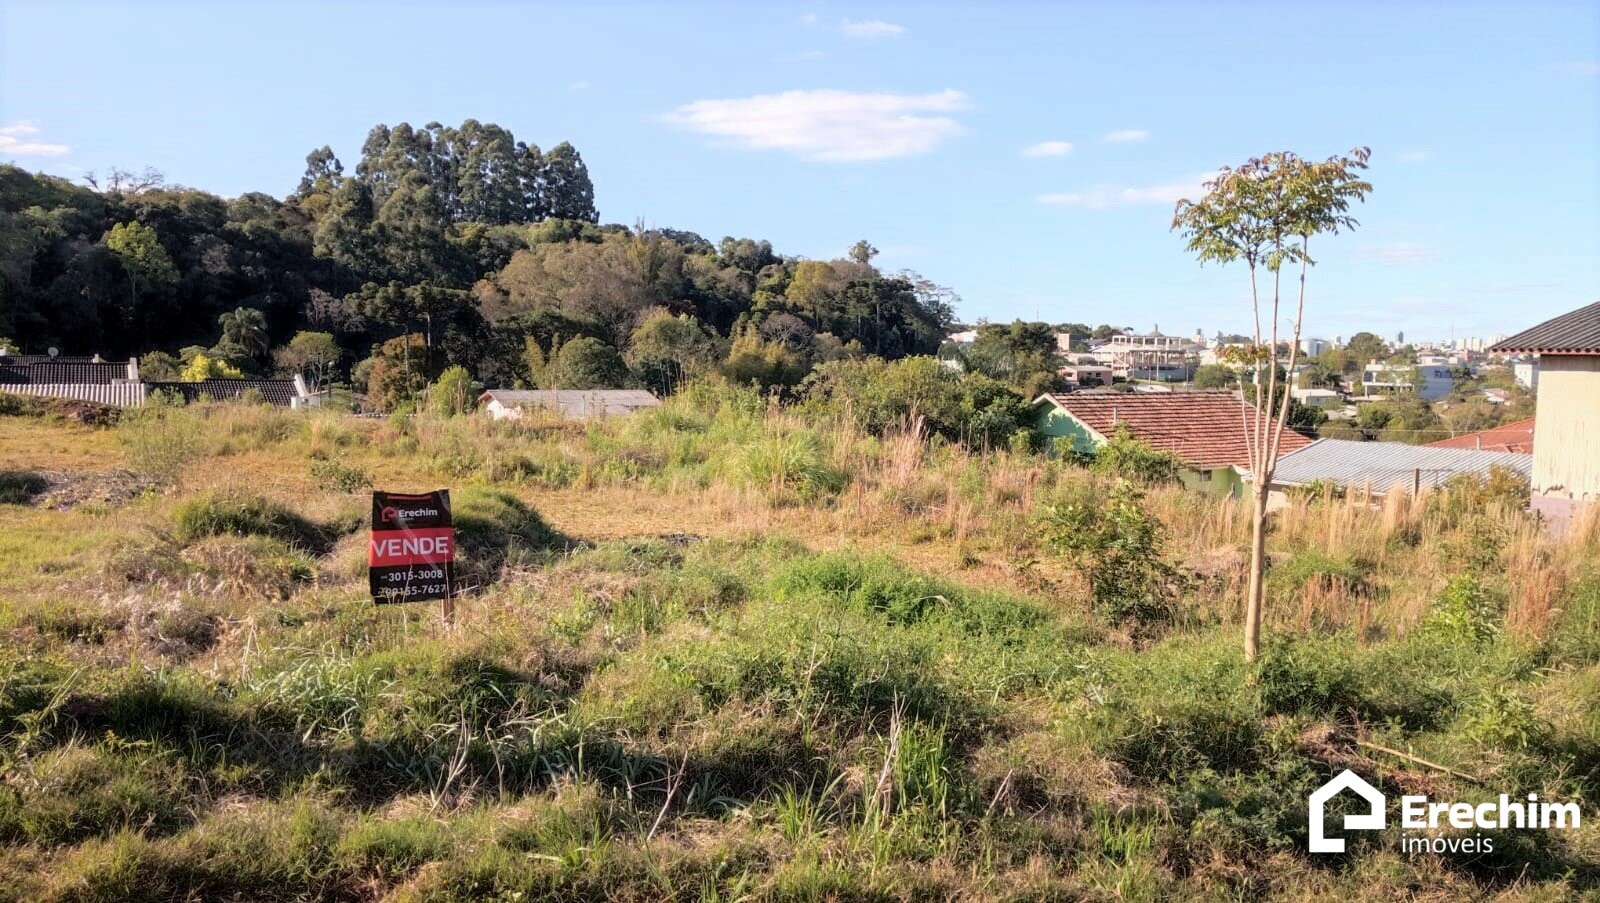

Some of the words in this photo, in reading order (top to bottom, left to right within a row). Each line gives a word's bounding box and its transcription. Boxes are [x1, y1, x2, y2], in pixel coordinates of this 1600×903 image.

[399, 507, 438, 517] Erechim
[371, 536, 449, 558] VENDE
[388, 569, 443, 582] 3015-3008
